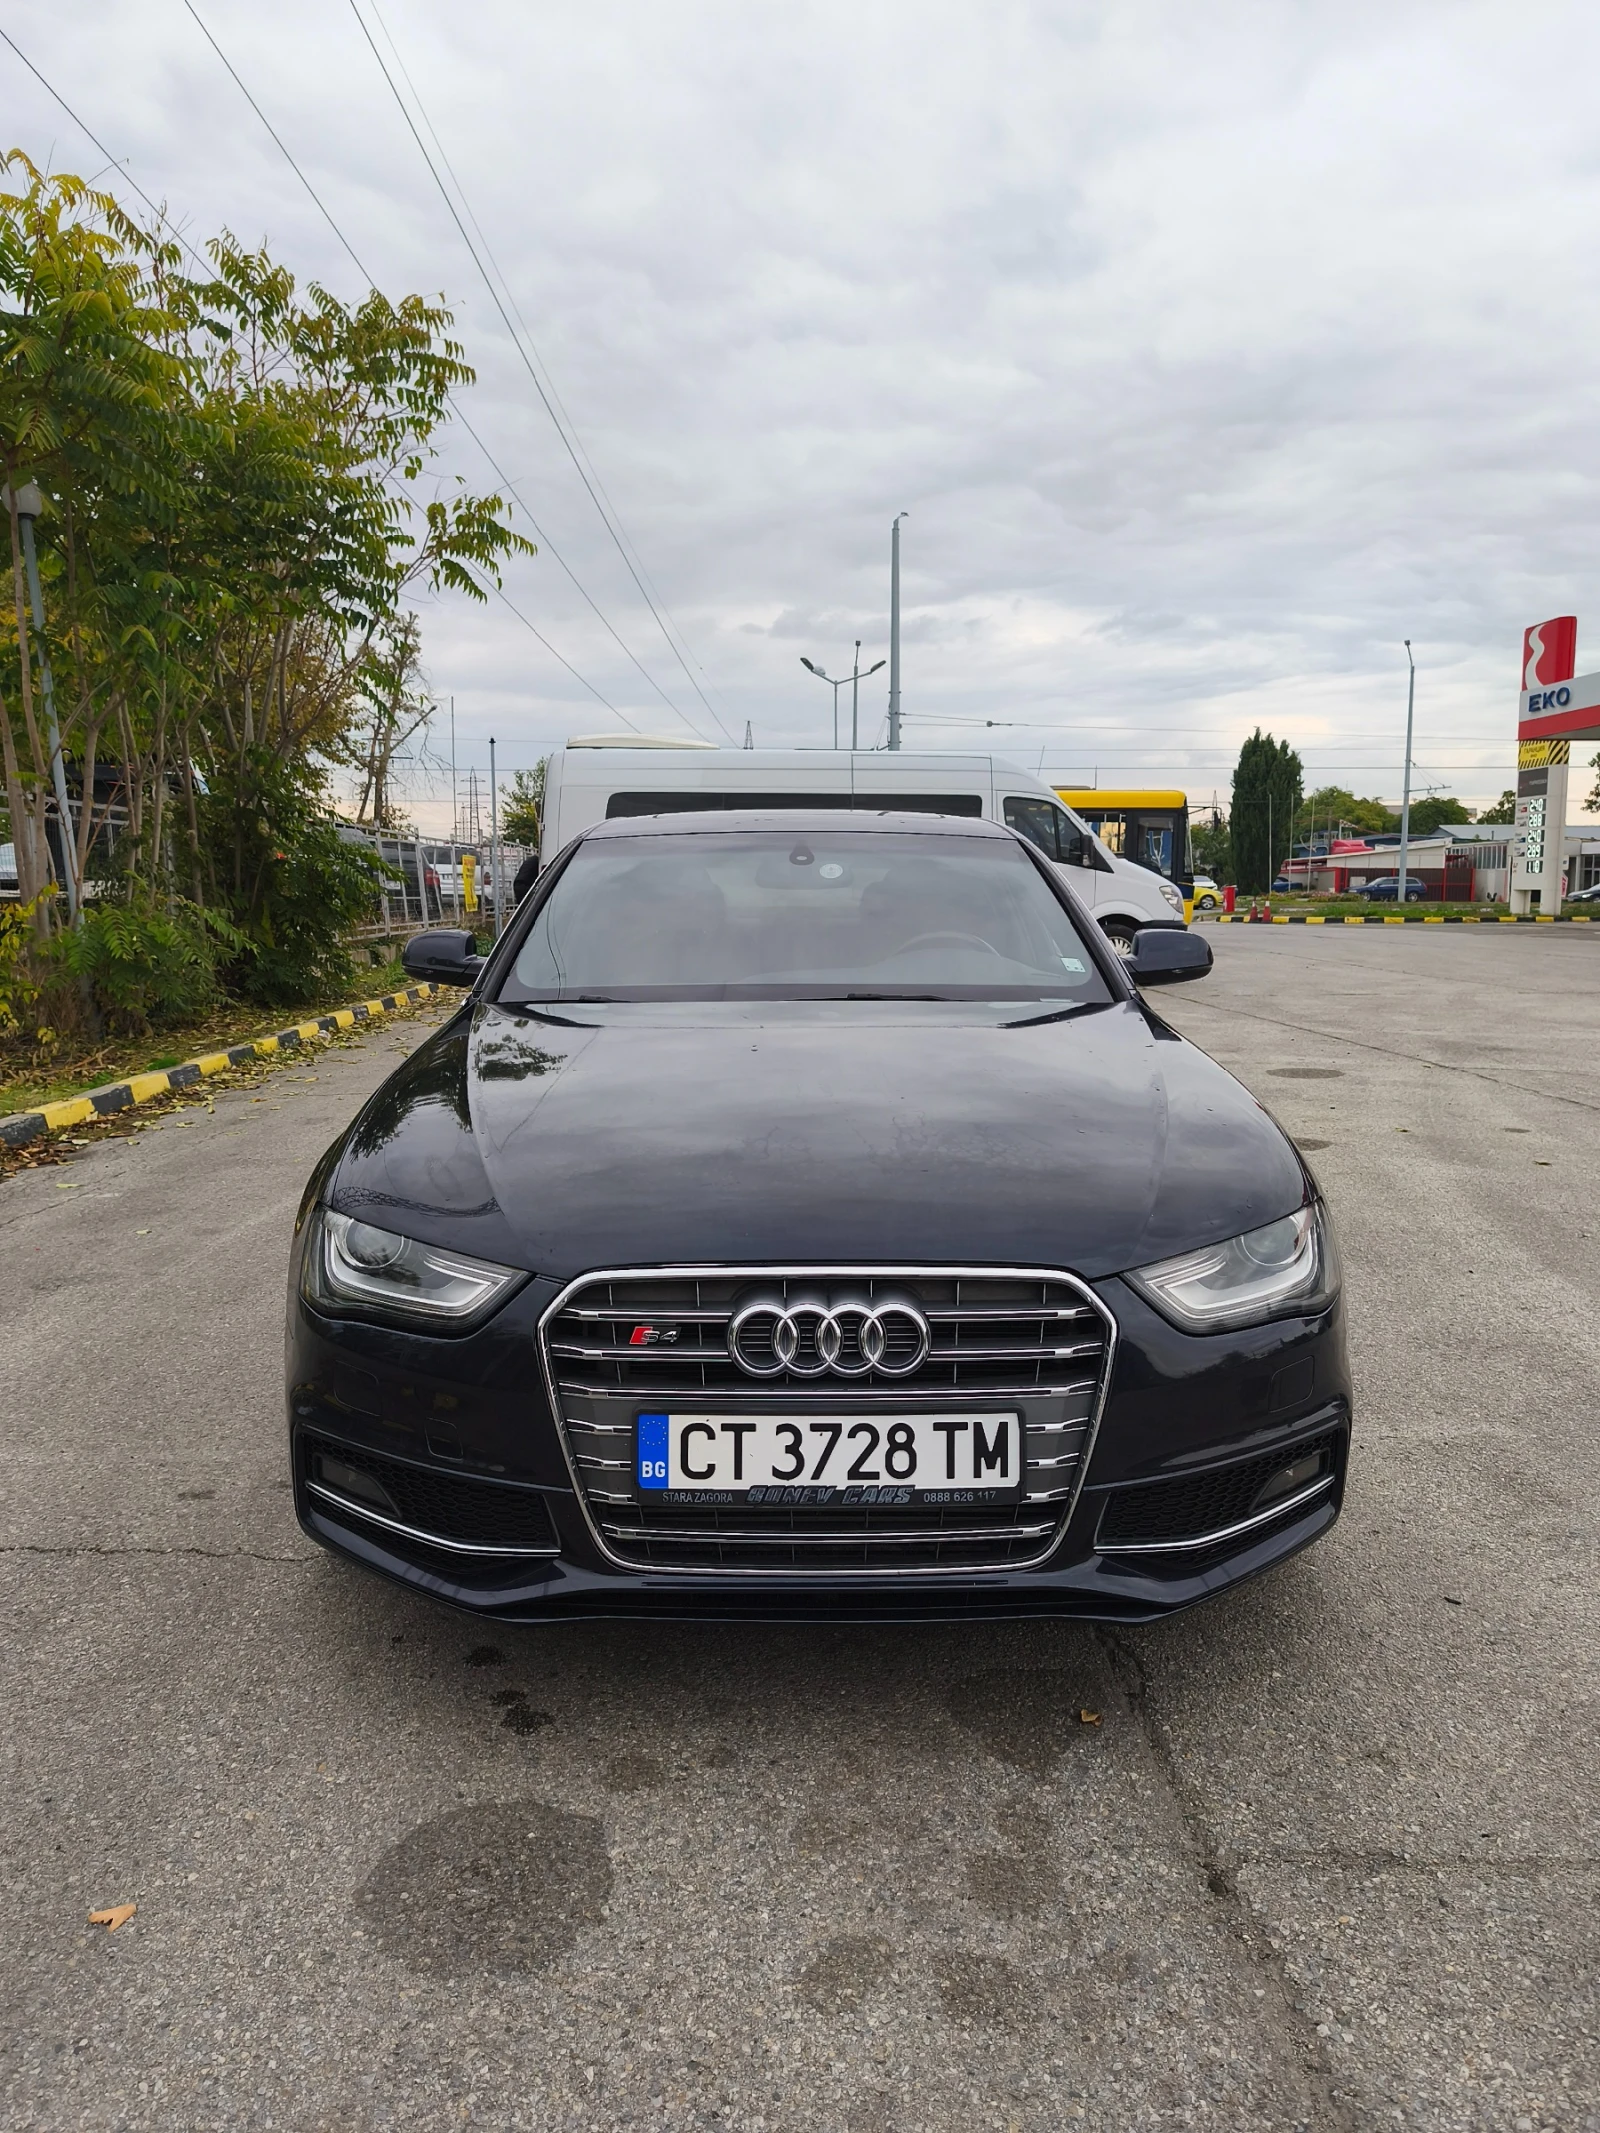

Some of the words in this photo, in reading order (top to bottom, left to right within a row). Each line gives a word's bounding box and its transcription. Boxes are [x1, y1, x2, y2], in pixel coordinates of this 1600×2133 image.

[1529, 687, 1570, 712] EKO
[640, 1330, 678, 1343] S4
[680, 1422, 756, 1481] CT
[771, 1422, 917, 1481] 3728
[932, 1421, 1009, 1480] TM
[641, 1461, 666, 1478] BG
[663, 1491, 693, 1503] STARA
[694, 1492, 734, 1504] ZAGORA
[841, 1486, 914, 1504] CARS
[923, 1491, 951, 1503] 0888
[953, 1491, 974, 1502] 626
[977, 1490, 996, 1501] 117
